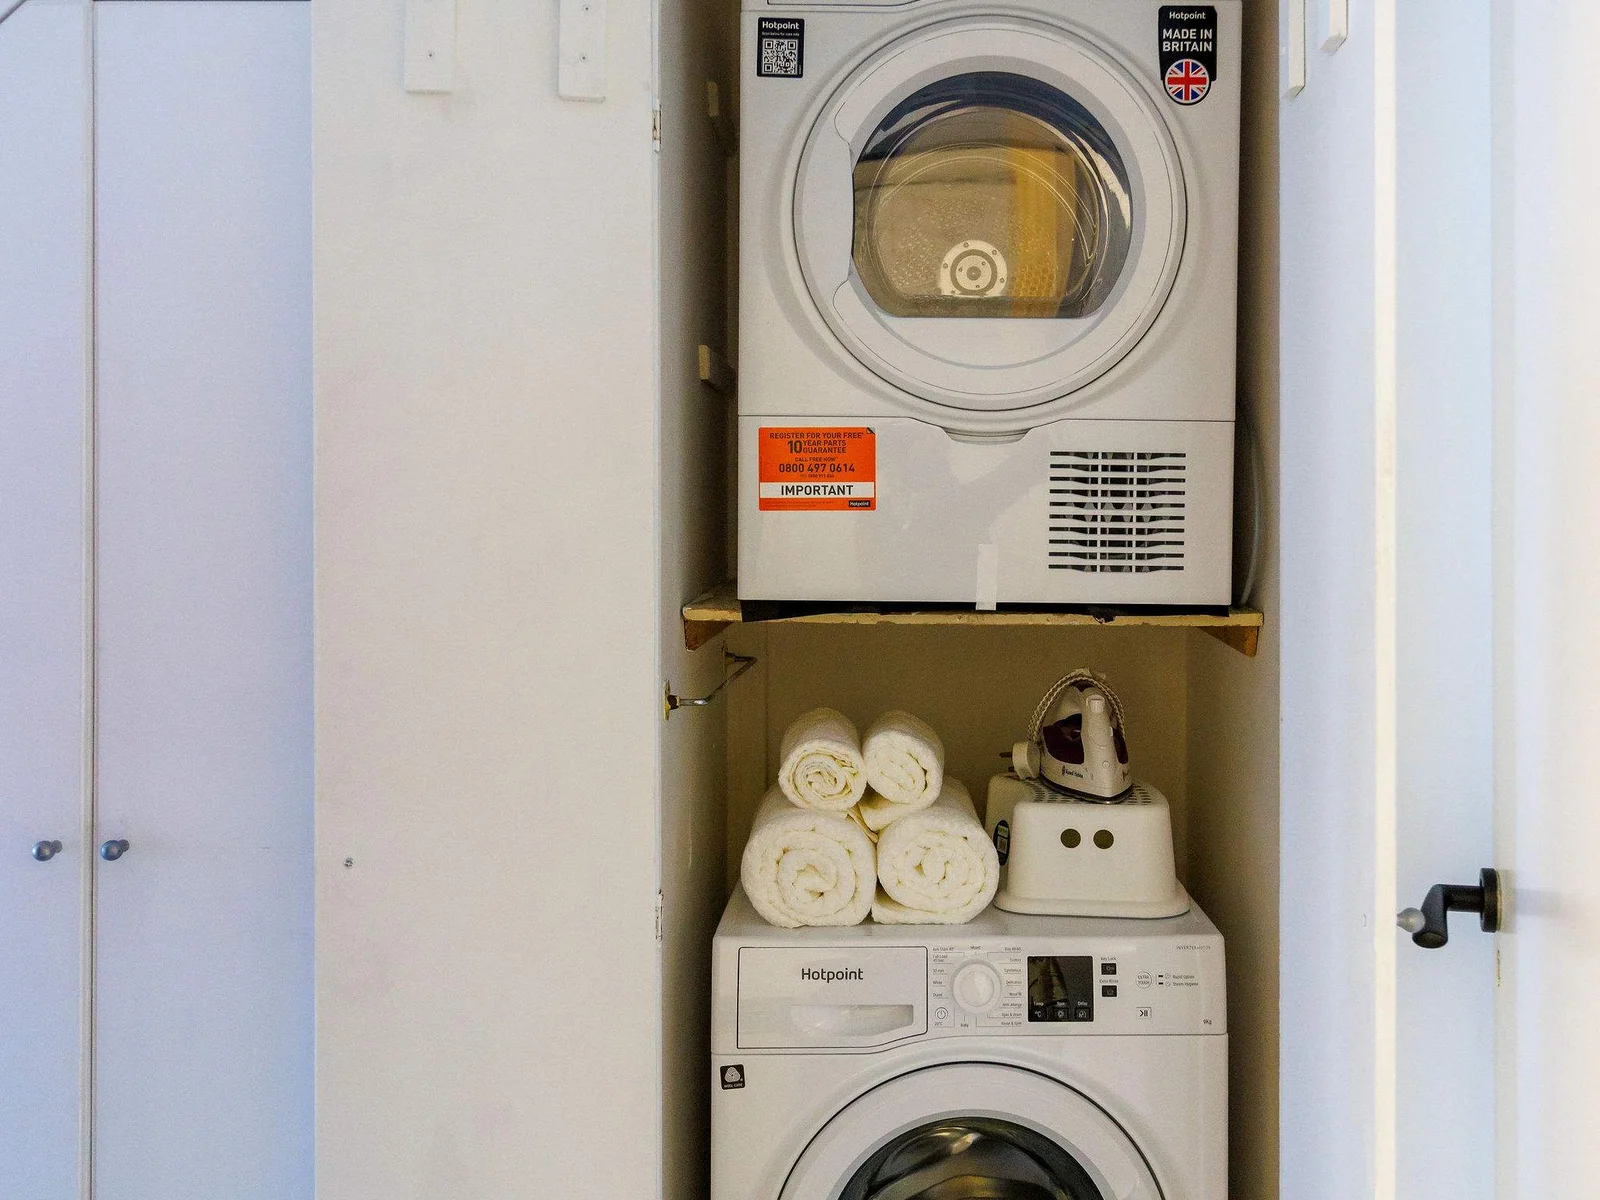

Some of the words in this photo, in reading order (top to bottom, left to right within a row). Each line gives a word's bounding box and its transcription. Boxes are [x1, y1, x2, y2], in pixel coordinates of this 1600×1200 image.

[1169, 11, 1206, 20] Hotpoint
[762, 21, 799, 30] Hotpoint
[1162, 28, 1197, 39] MADE
[1200, 28, 1212, 39] IN
[1162, 41, 1212, 52] BRITAIN
[788, 440, 802, 454] 10
[779, 463, 804, 472] 0800
[807, 463, 827, 472] 497
[829, 463, 855, 472] 0614
[781, 485, 854, 496] IMPORTANT
[801, 968, 864, 983] Hotpoint
